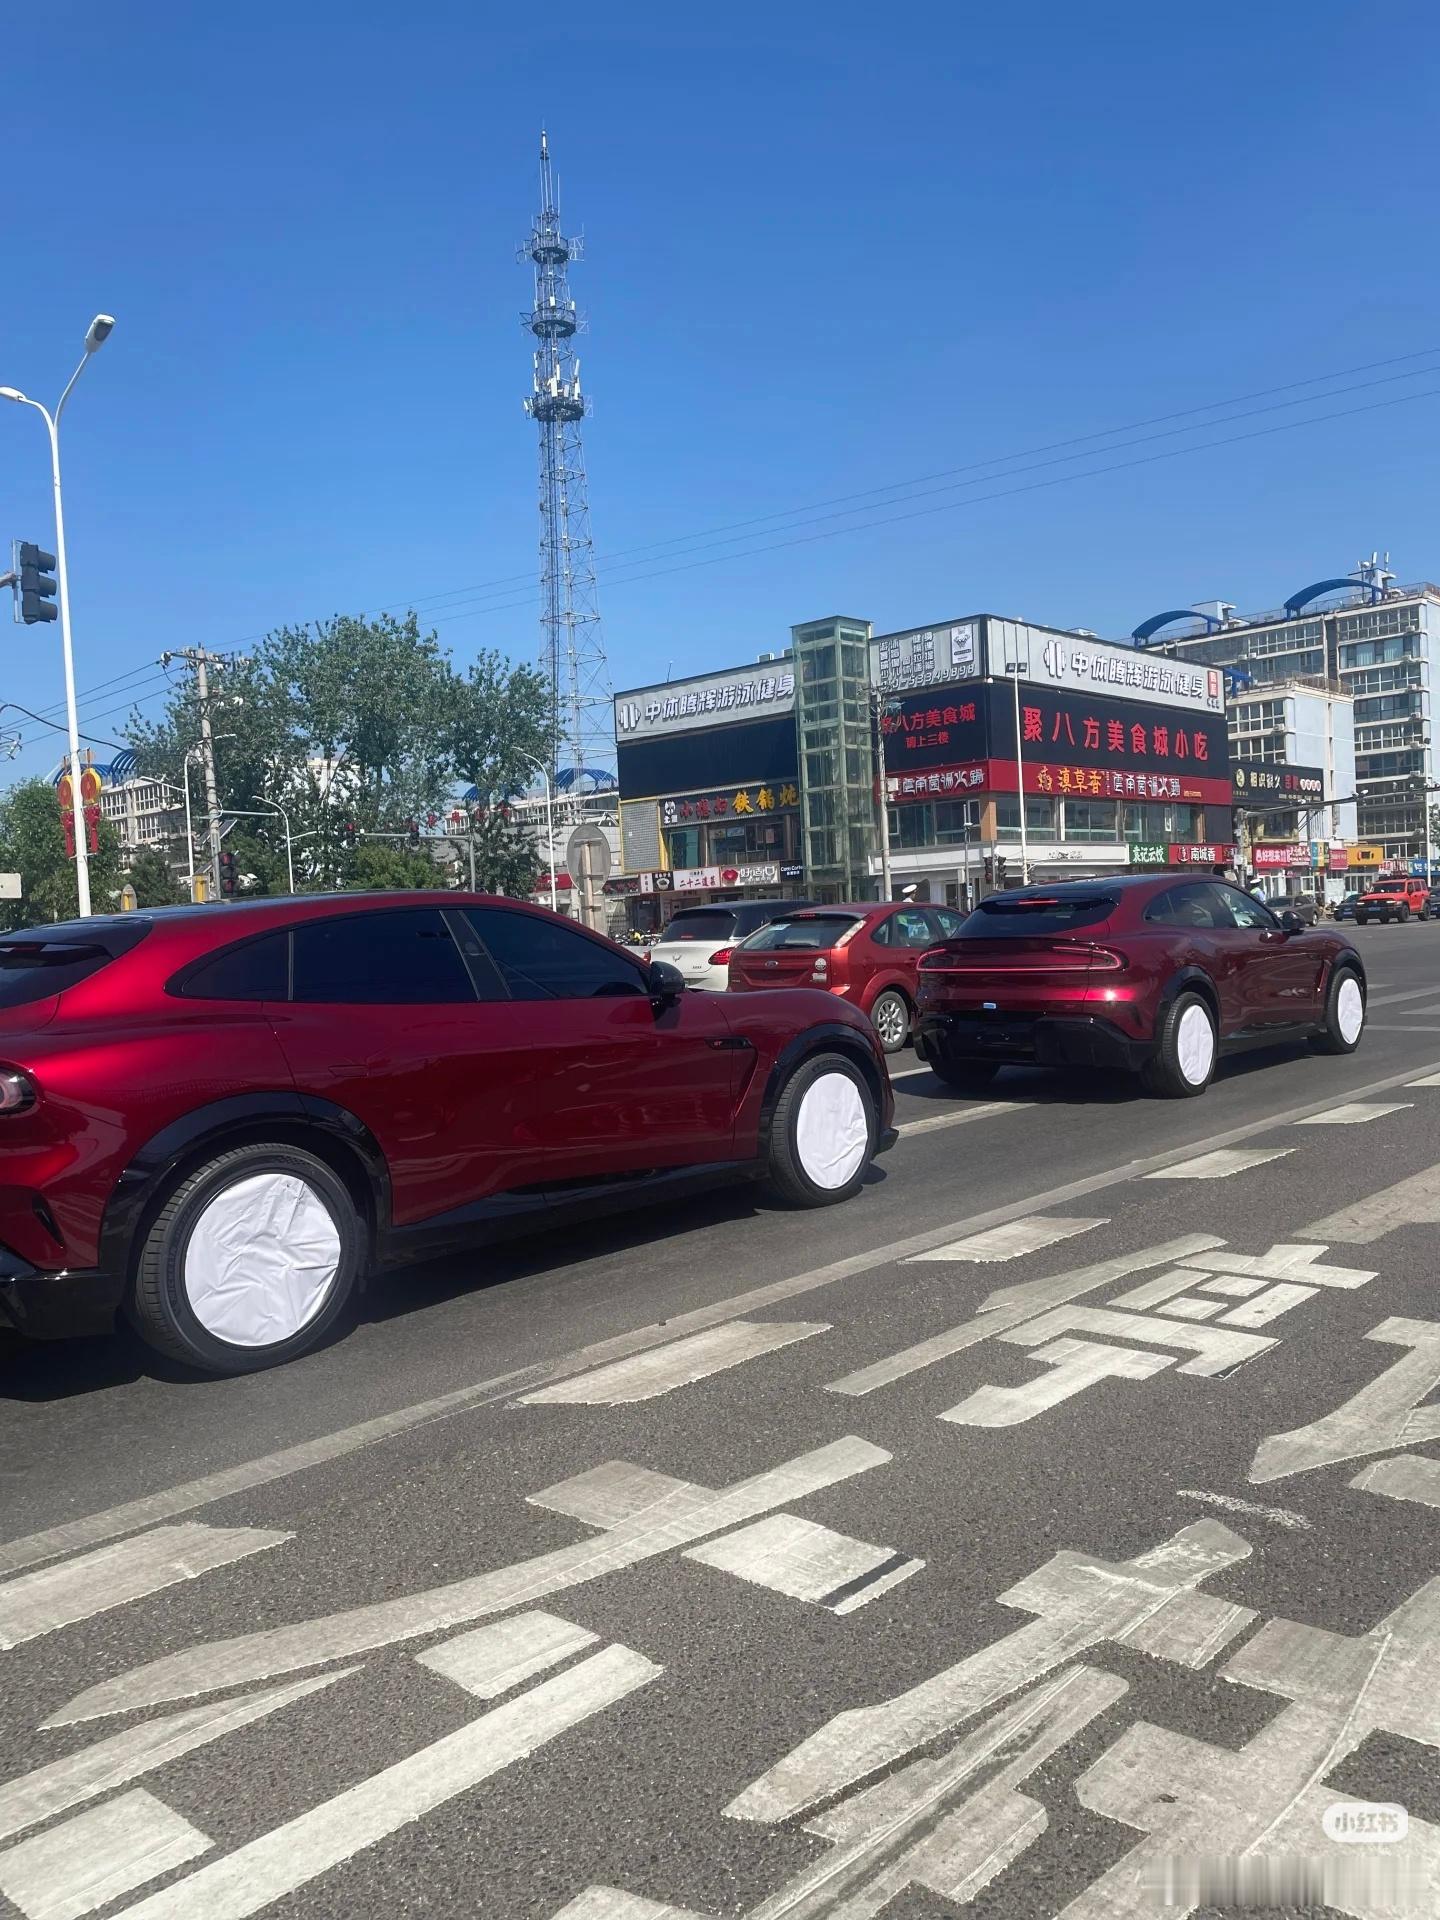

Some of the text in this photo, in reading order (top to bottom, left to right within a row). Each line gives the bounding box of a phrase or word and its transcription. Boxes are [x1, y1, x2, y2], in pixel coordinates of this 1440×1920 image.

[1071, 652, 1205, 697] 中体腾辉游泳健身
[1022, 706, 1209, 761] 聚八方美食城小吃
[1132, 846, 1166, 863] 袁记云饺
[1190, 847, 1216, 861] 南城香
